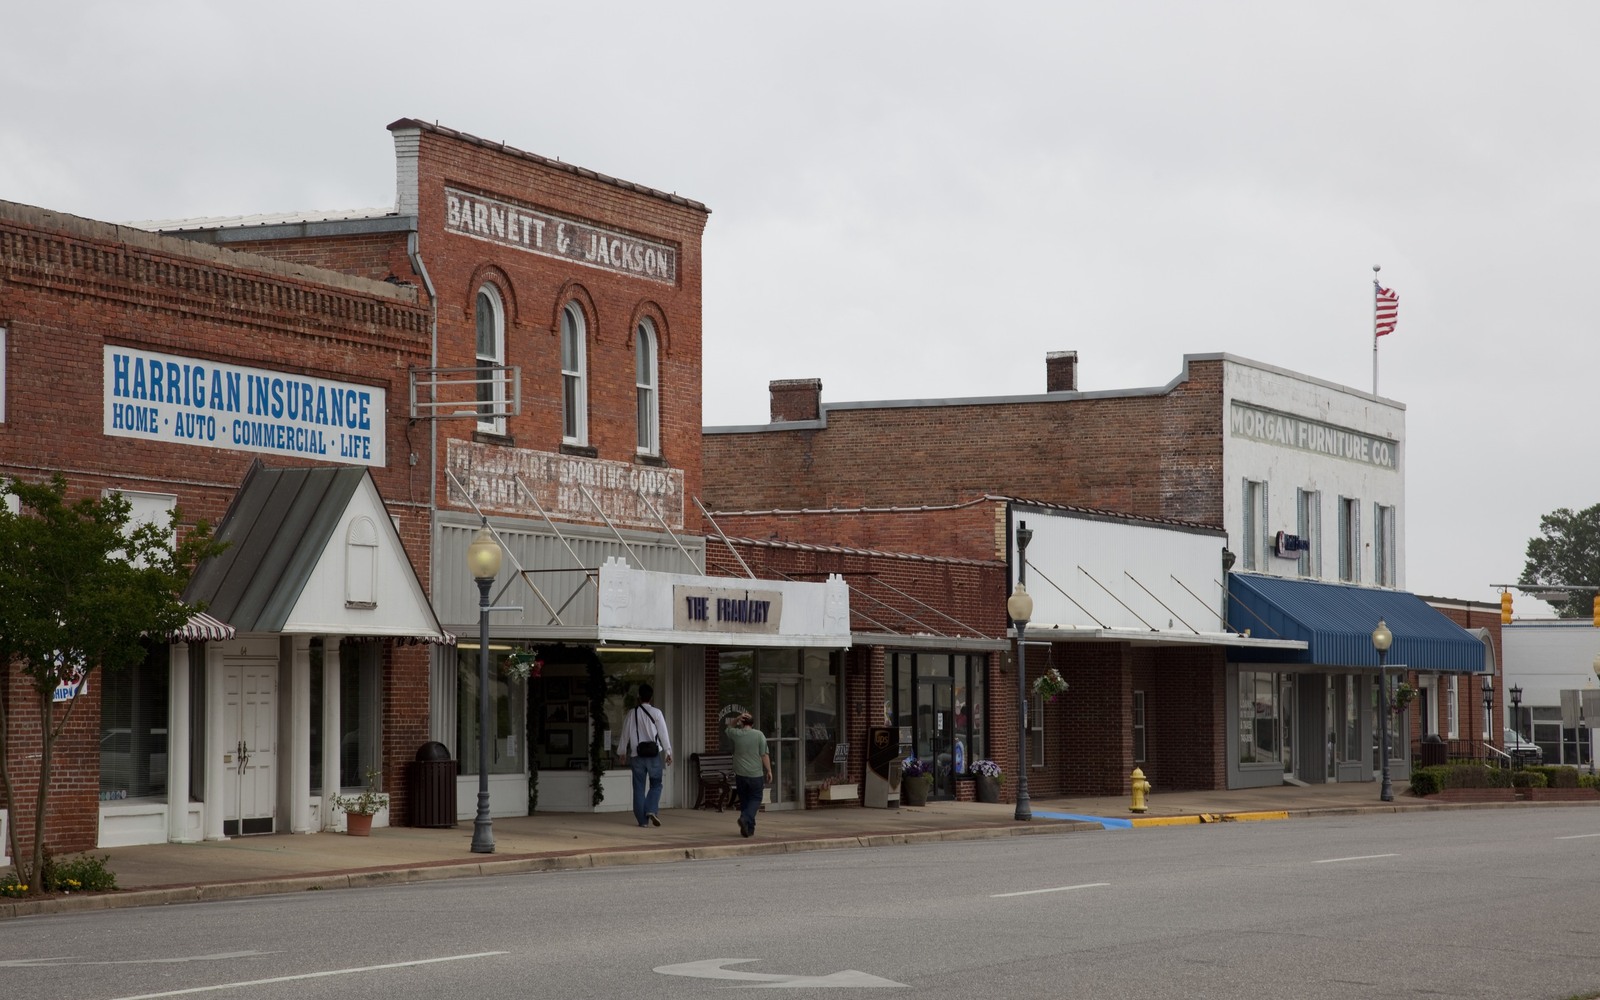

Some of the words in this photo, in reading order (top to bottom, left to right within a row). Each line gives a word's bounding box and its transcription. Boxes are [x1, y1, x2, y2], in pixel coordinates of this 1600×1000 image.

[448, 196, 545, 247] BARNETT
[556, 223, 571, 254] &
[585, 231, 668, 278] JACKSON
[113, 354, 241, 413] HARRIGAN
[247, 374, 371, 431] INSURANCE
[113, 403, 158, 434] HOME
[174, 412, 216, 442] AUTO
[232, 419, 327, 455] COMMERCIAL
[340, 433, 371, 460] LIFE
[1231, 408, 1293, 445] MORGAN
[1298, 423, 1369, 461] FURNITURE
[1372, 440, 1391, 466] CO.
[469, 475, 526, 505] PAINTS
[558, 486, 665, 519] HOUSEWARS
[559, 461, 626, 490] SPORTING
[630, 469, 675, 495] GOODS
[686, 596, 709, 621] THE
